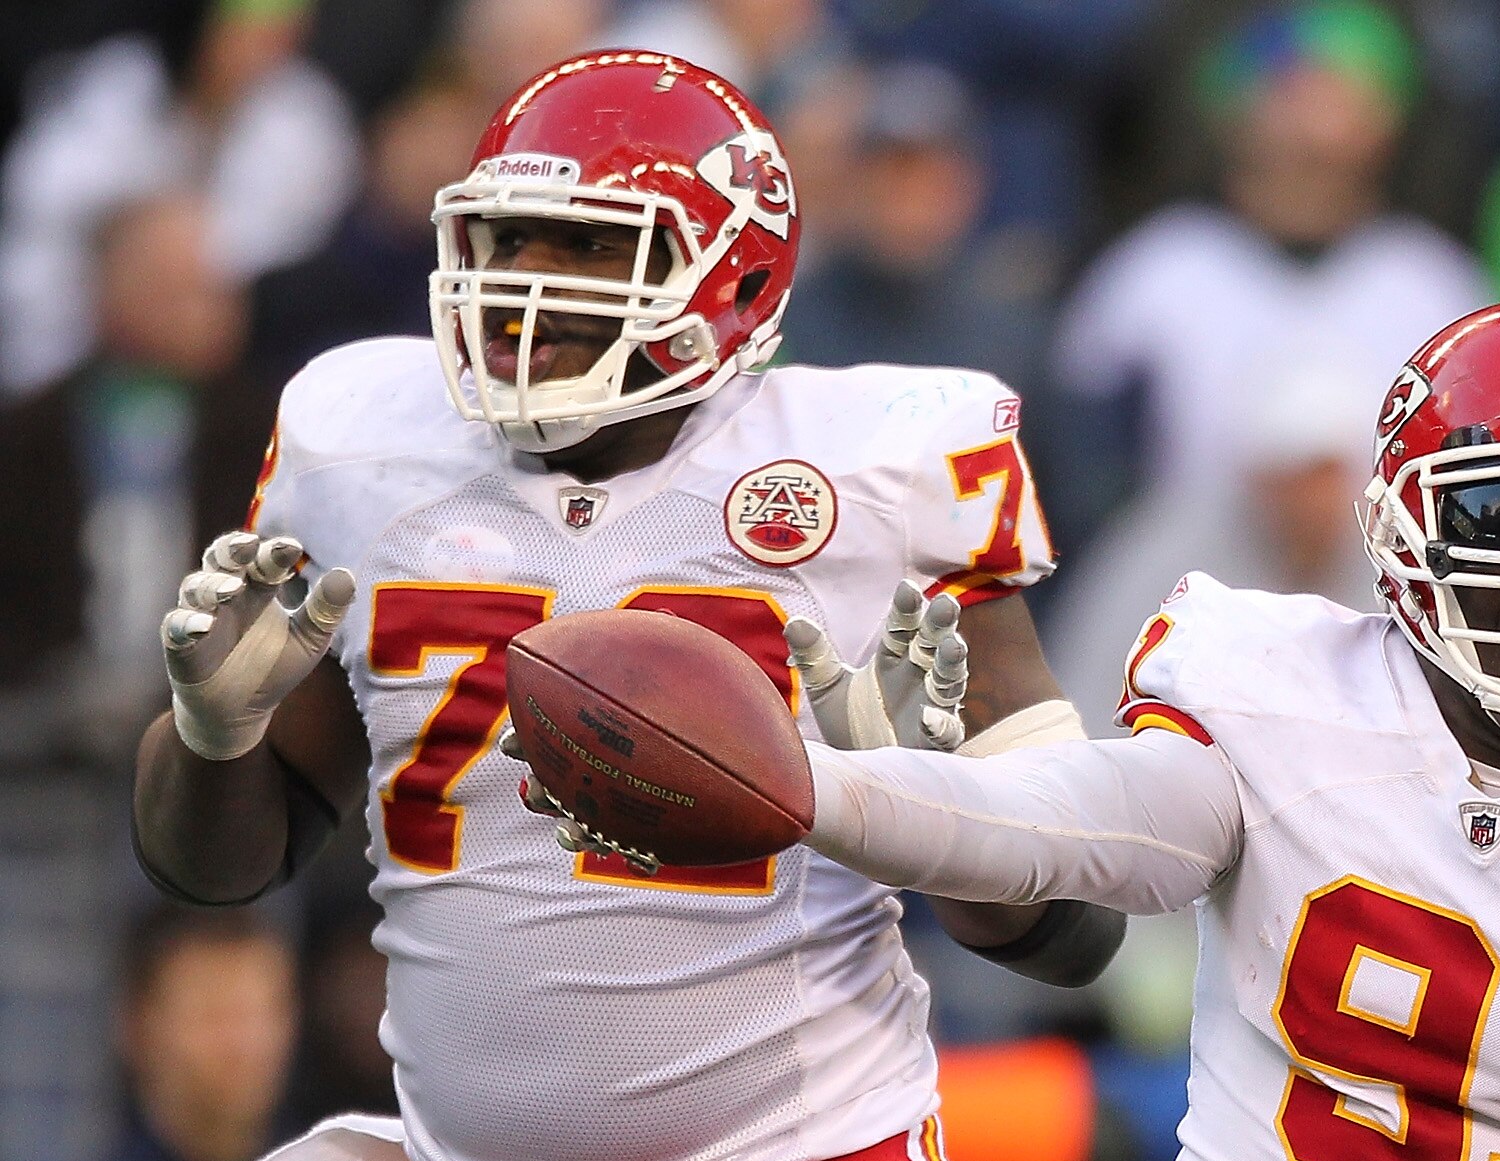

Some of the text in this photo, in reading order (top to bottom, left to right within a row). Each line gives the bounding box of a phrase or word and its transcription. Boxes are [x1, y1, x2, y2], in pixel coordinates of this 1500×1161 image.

[497, 160, 553, 177] Riddell
[945, 434, 1058, 578] 7
[559, 732, 621, 780] FOOTBALL
[624, 773, 697, 808] NATIONAL
